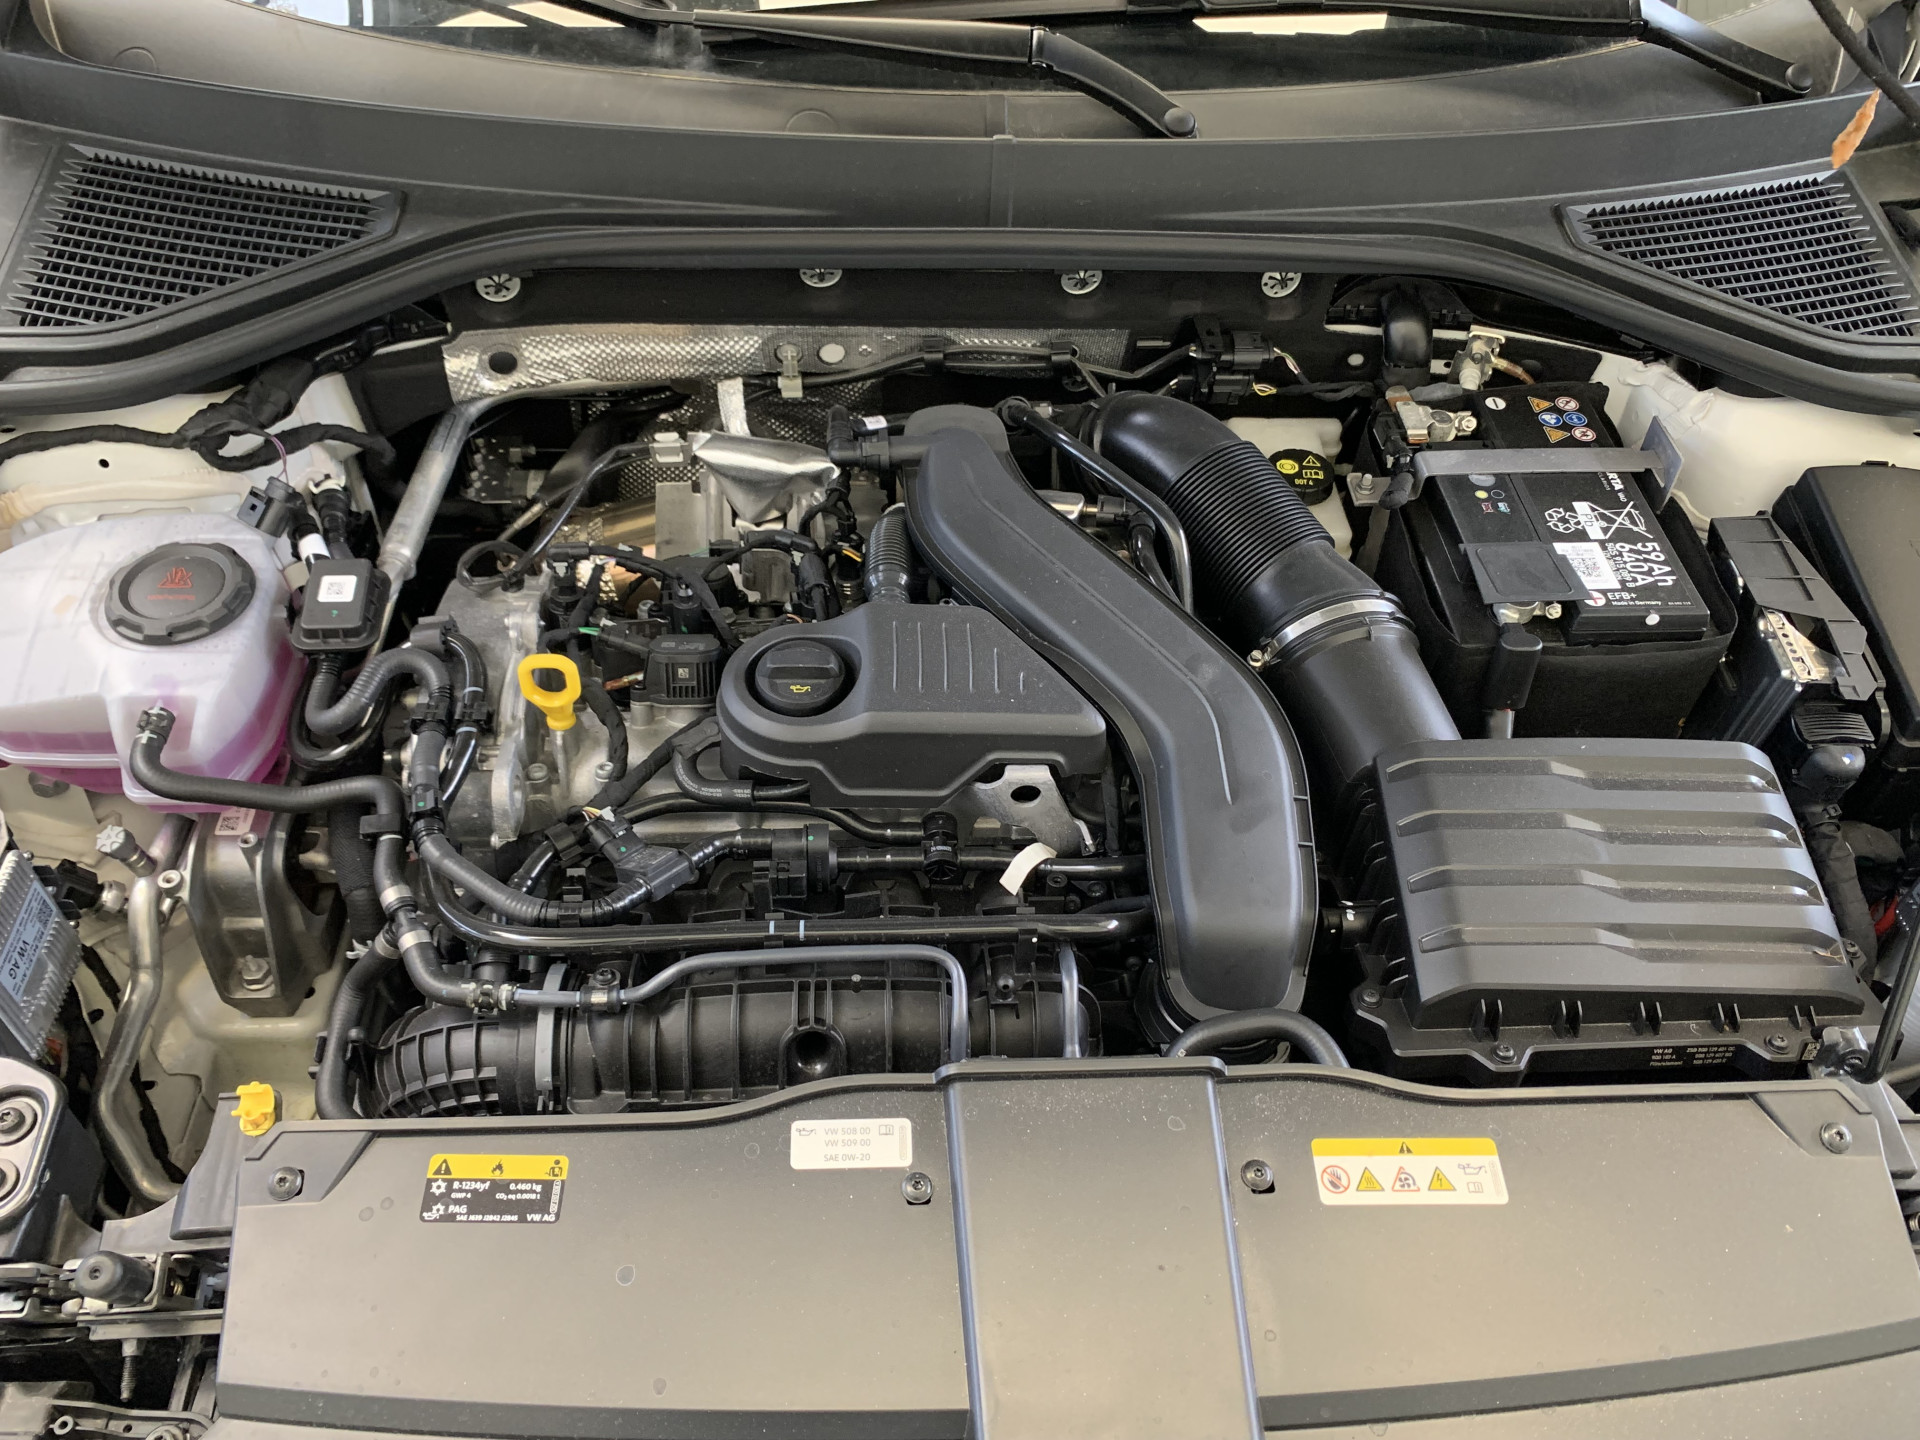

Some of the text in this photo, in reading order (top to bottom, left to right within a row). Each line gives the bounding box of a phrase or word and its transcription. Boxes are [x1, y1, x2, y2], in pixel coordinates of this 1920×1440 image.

[1580, 513, 1594, 527] Pb
[1612, 556, 1626, 569] 915
[1615, 542, 1656, 587] 640A
[1636, 542, 1677, 586] 59Ah
[1607, 592, 1637, 600] EFB+
[824, 1126, 871, 1136] VW 508 00
[824, 1138, 871, 1148] VW 509 00
[823, 1152, 871, 1162] SAE 0W-20
[452, 1181, 542, 1192] R-1234yf 0.460 kg
[447, 1204, 468, 1214] PAG
[483, 1214, 501, 1222] J2842
[526, 1213, 542, 1222] VW
[542, 1213, 556, 1222] AG
